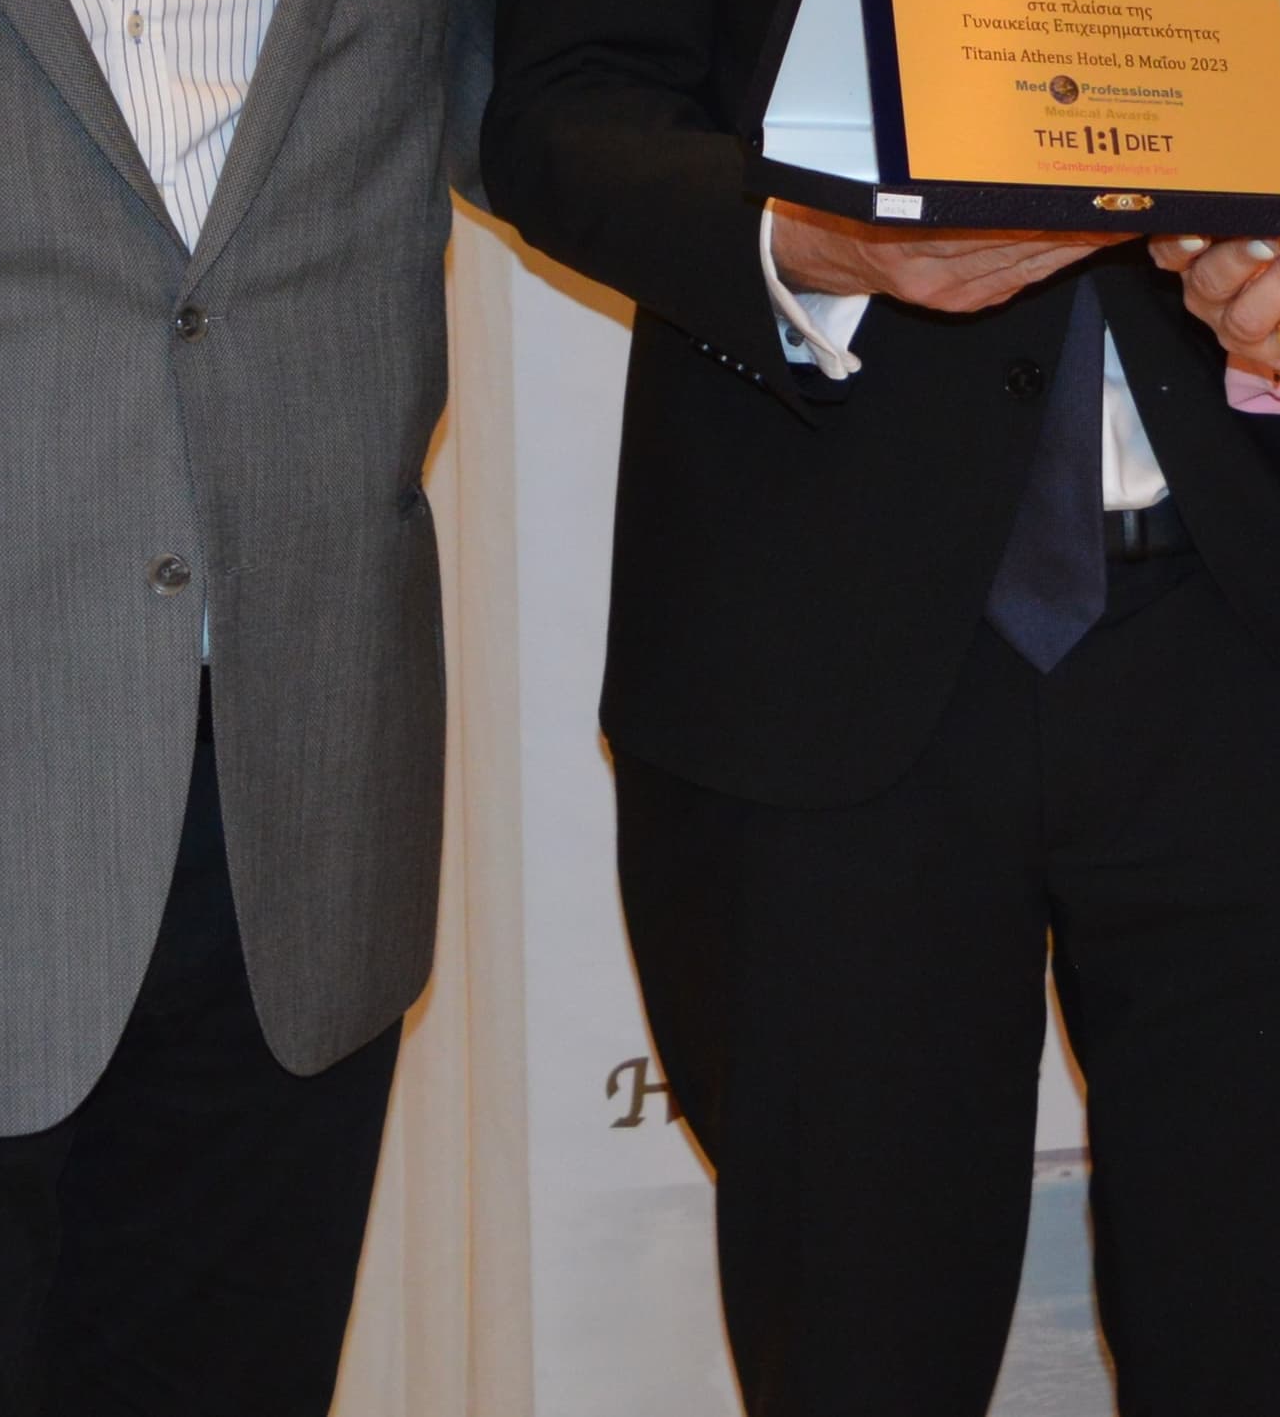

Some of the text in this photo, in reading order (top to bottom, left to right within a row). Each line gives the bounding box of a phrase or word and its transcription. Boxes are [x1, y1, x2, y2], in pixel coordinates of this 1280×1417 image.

[1027, 0, 1153, 21] στα πλαίσια της
[961, 45, 1016, 62] Titania
[1020, 48, 1073, 65] Athens
[1076, 52, 1122, 69] Hotel,
[1125, 54, 1135, 69] 8
[1190, 57, 1229, 73] 2023
[1015, 79, 1184, 99] Med Professionals
[1034, 125, 1174, 156] THE 1:1 DIET
